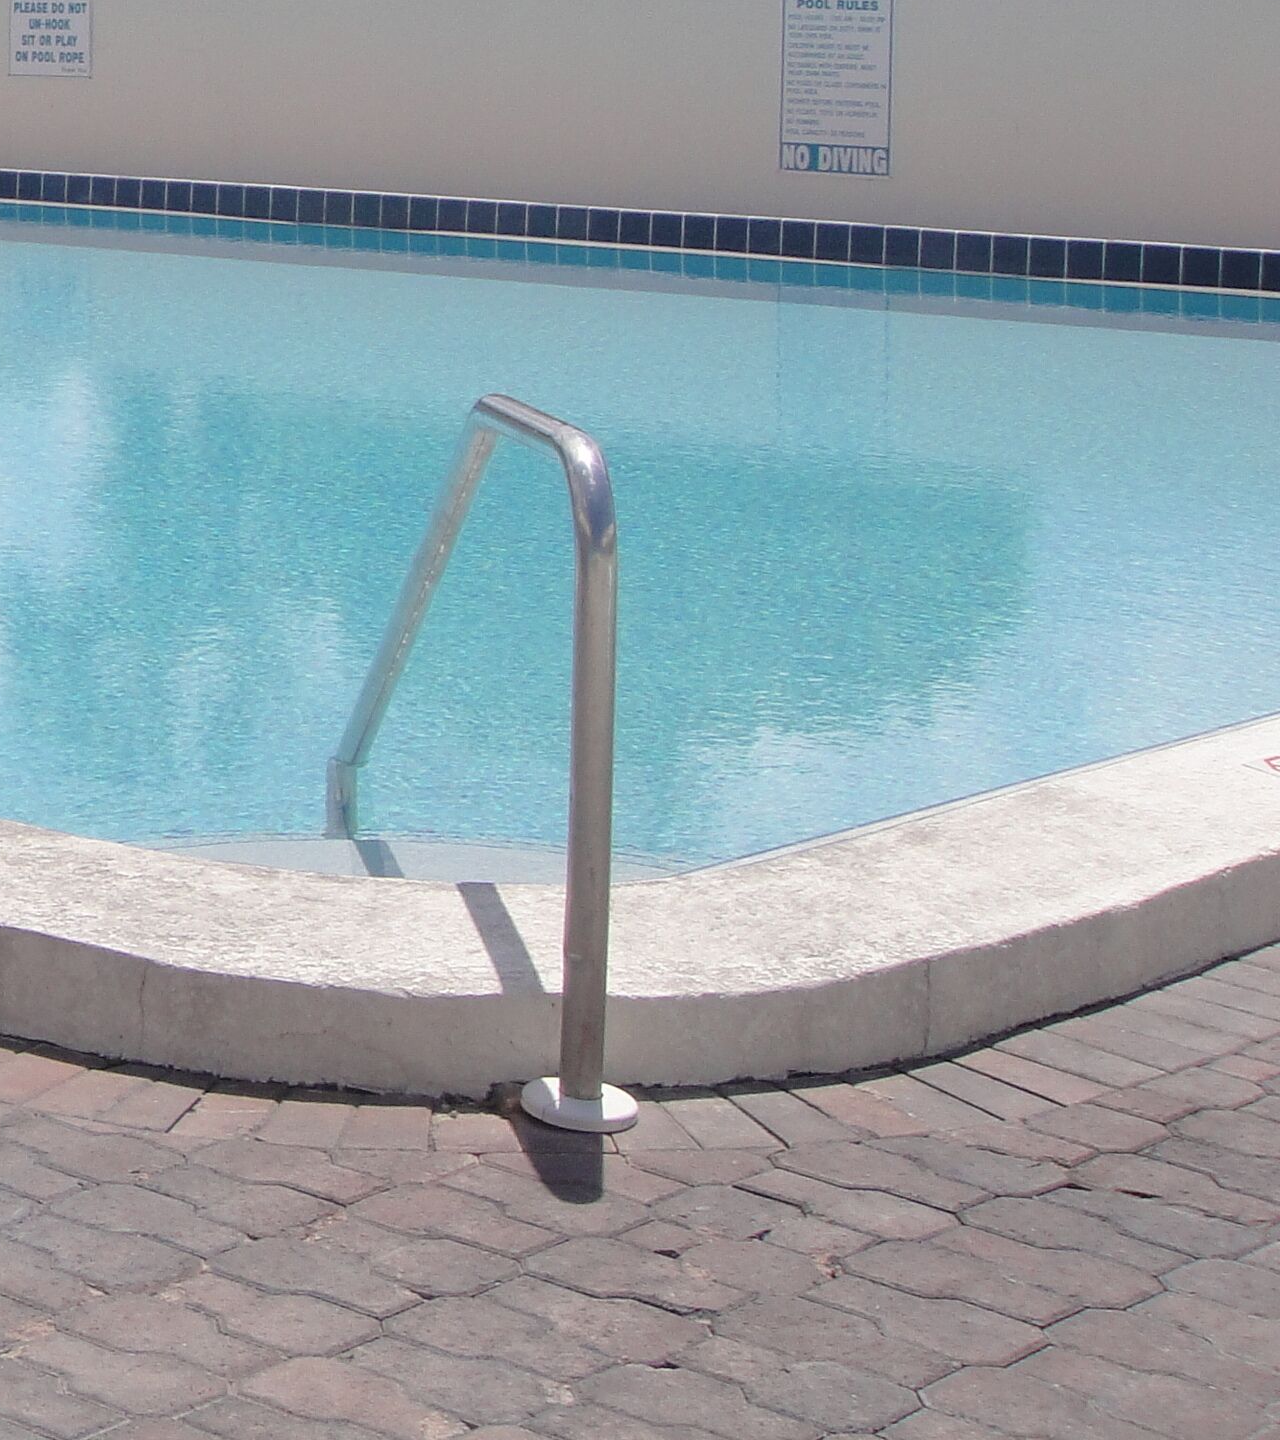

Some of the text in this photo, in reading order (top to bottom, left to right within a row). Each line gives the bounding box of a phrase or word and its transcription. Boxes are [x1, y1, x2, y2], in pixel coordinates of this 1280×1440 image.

[14, 2, 87, 14] PLEASE DO NOT
[797, 0, 878, 11] POOL RULES
[29, 19, 71, 30] UN-HOOK
[22, 35, 77, 47] SIT OR PLAY
[16, 51, 84, 63] ON POOL ROPE
[783, 144, 887, 175] NO DIVING
